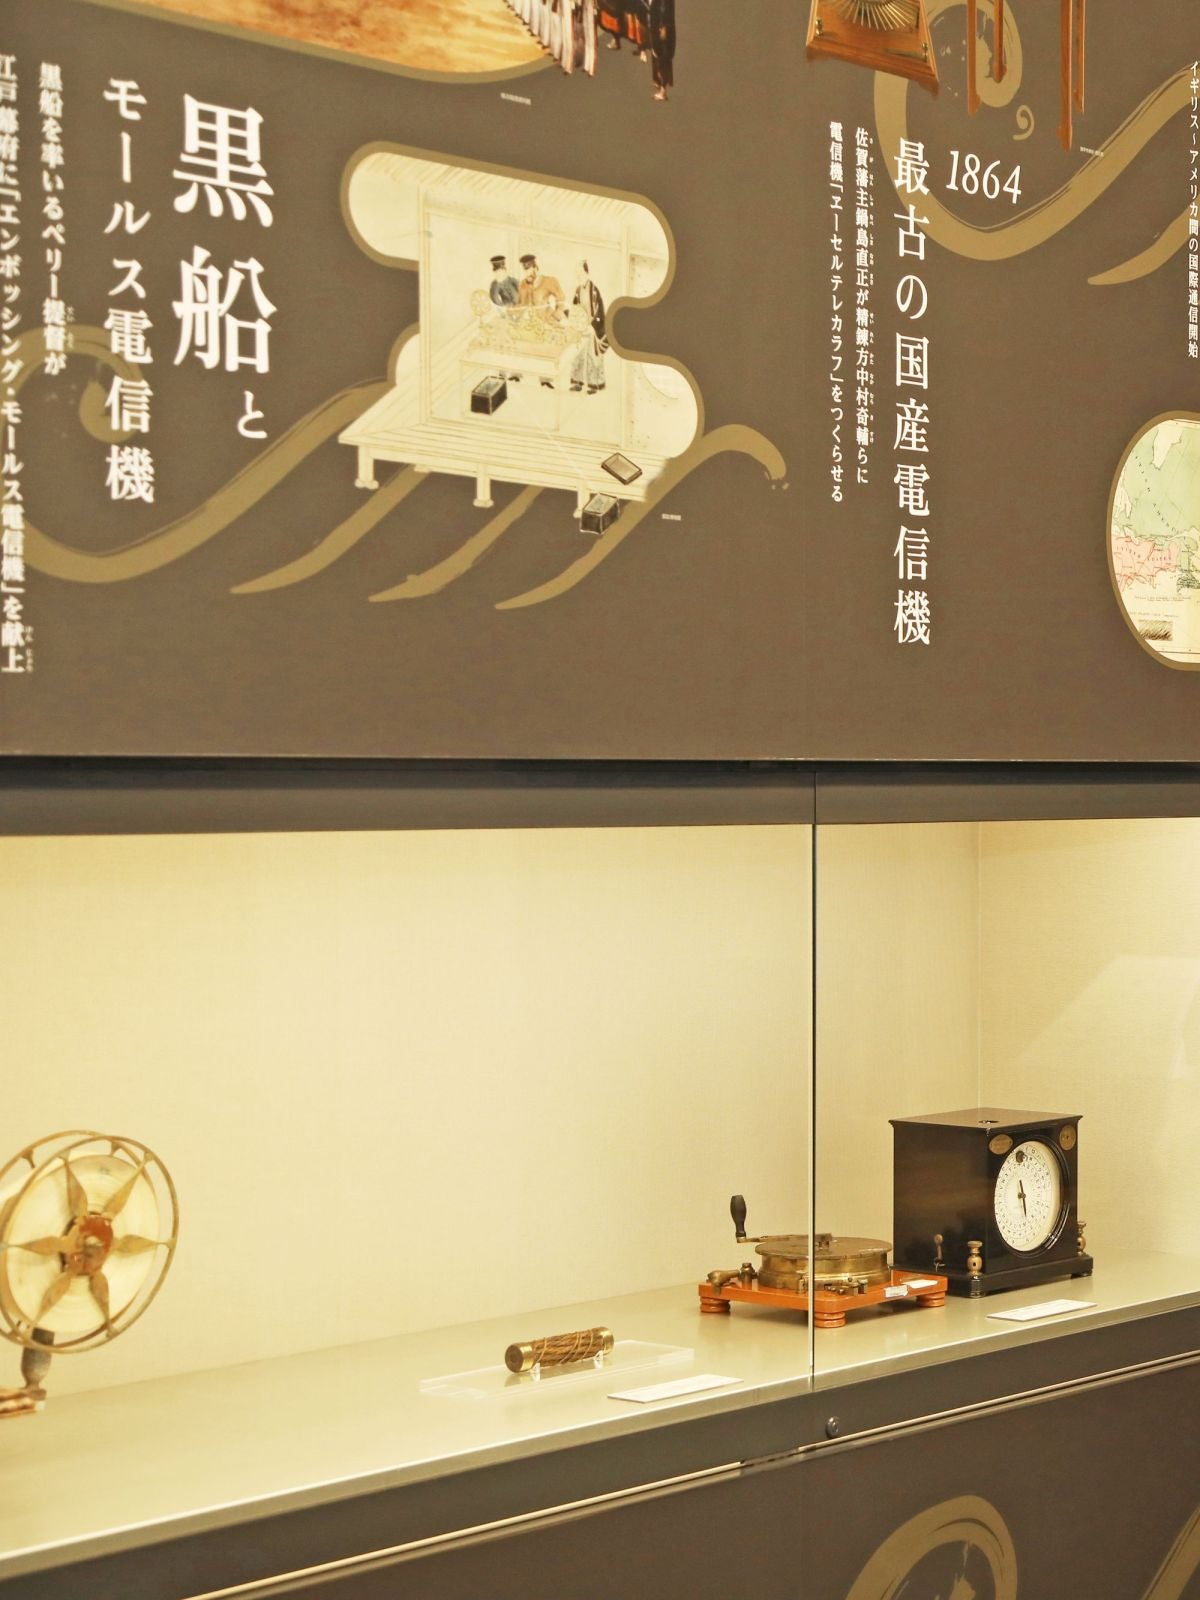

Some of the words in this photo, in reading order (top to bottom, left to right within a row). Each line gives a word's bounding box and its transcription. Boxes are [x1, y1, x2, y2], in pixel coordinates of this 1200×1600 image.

[104, 79, 154, 503] モールス電信機
[946, 150, 1022, 204] 1864
[893, 137, 931, 645] 最古の国産電信機
